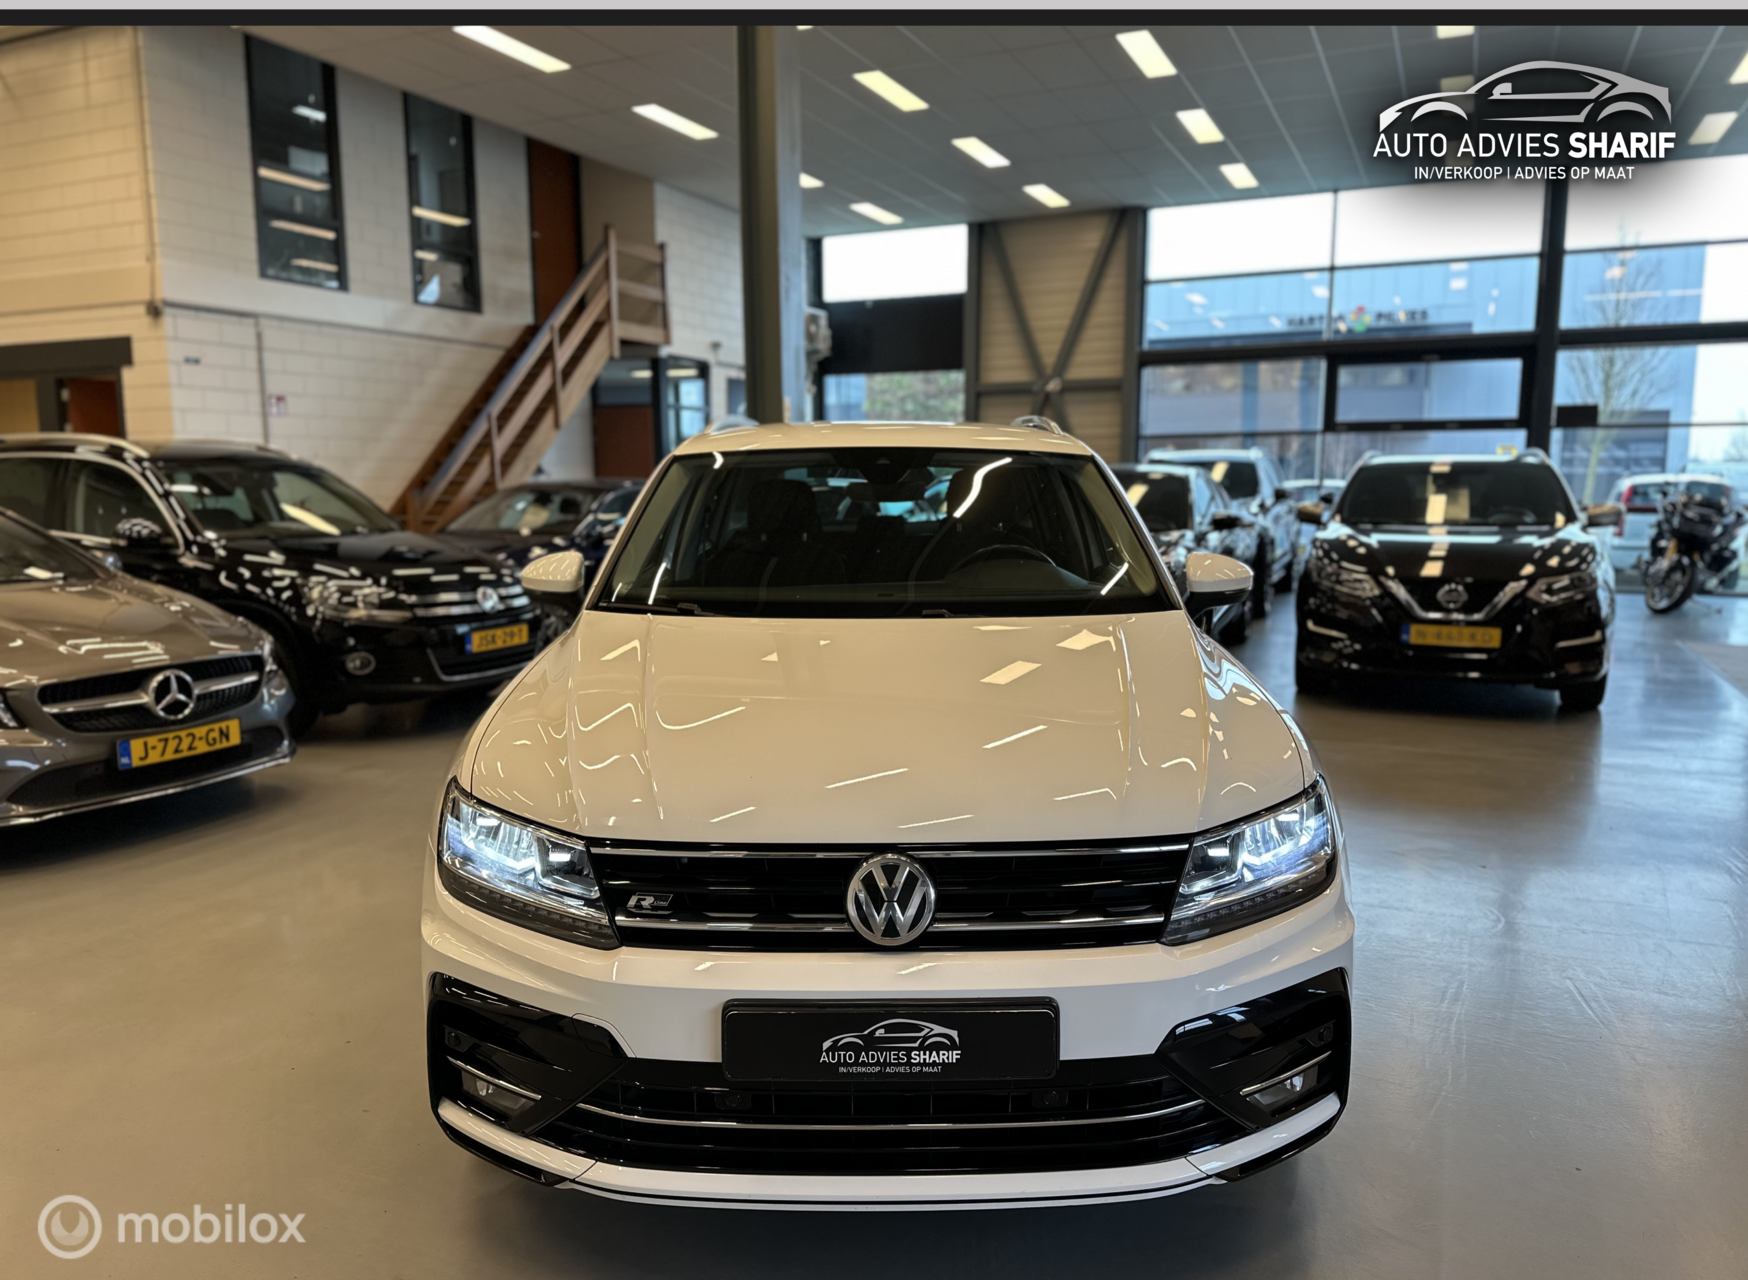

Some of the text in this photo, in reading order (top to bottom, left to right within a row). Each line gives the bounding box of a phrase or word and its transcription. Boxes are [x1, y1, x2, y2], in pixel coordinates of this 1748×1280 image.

[138, 724, 231, 761] J-722-GN
[819, 1050, 961, 1063] AUTO ADVIES SHARIF
